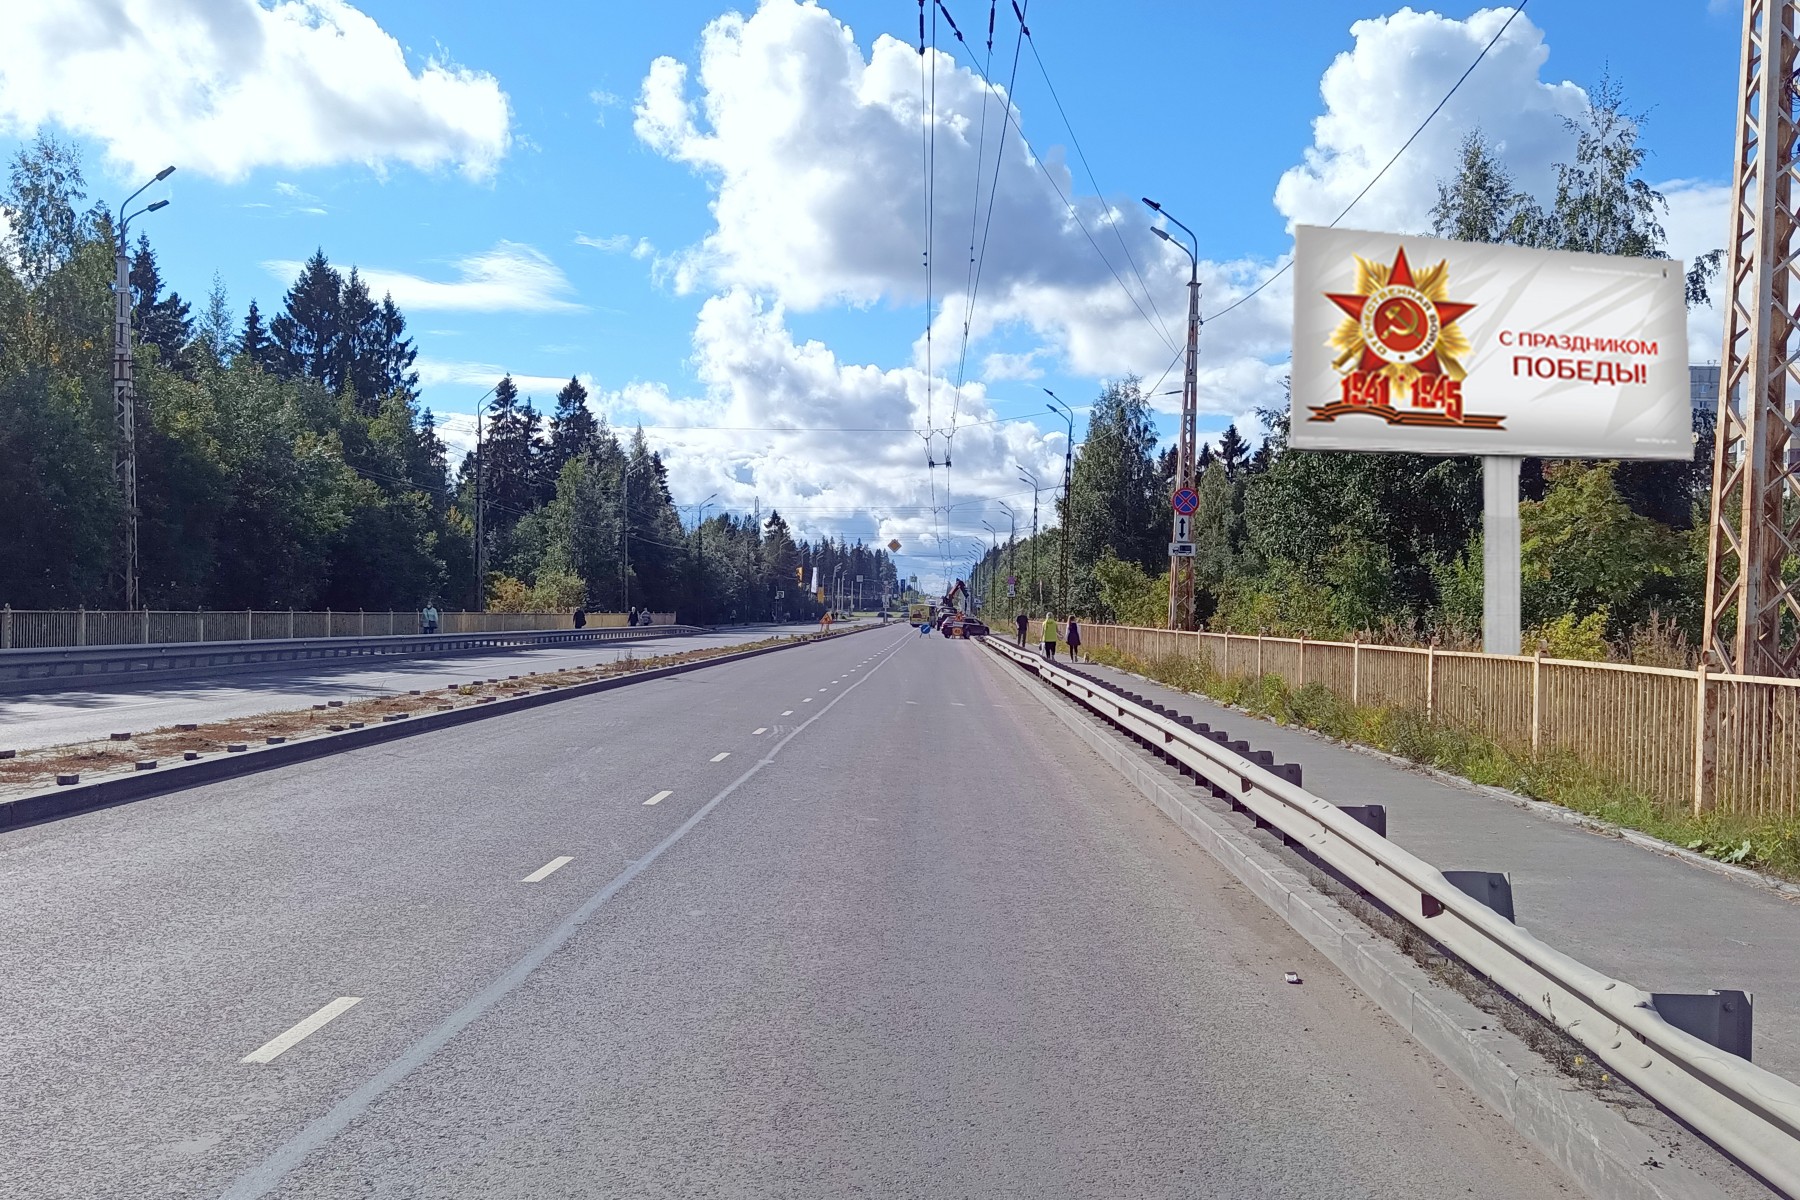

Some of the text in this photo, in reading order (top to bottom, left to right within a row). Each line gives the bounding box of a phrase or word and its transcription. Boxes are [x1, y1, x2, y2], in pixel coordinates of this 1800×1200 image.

[1364, 287, 1439, 357] ОТЕЧЕСТВЕННАЯ ВОЙНА
[1499, 330, 1659, 356] С ПРАЗДНИКОМ
[1512, 355, 1648, 387] ПОБЕДЫ!
[1341, 370, 1465, 424] 1941 1945
